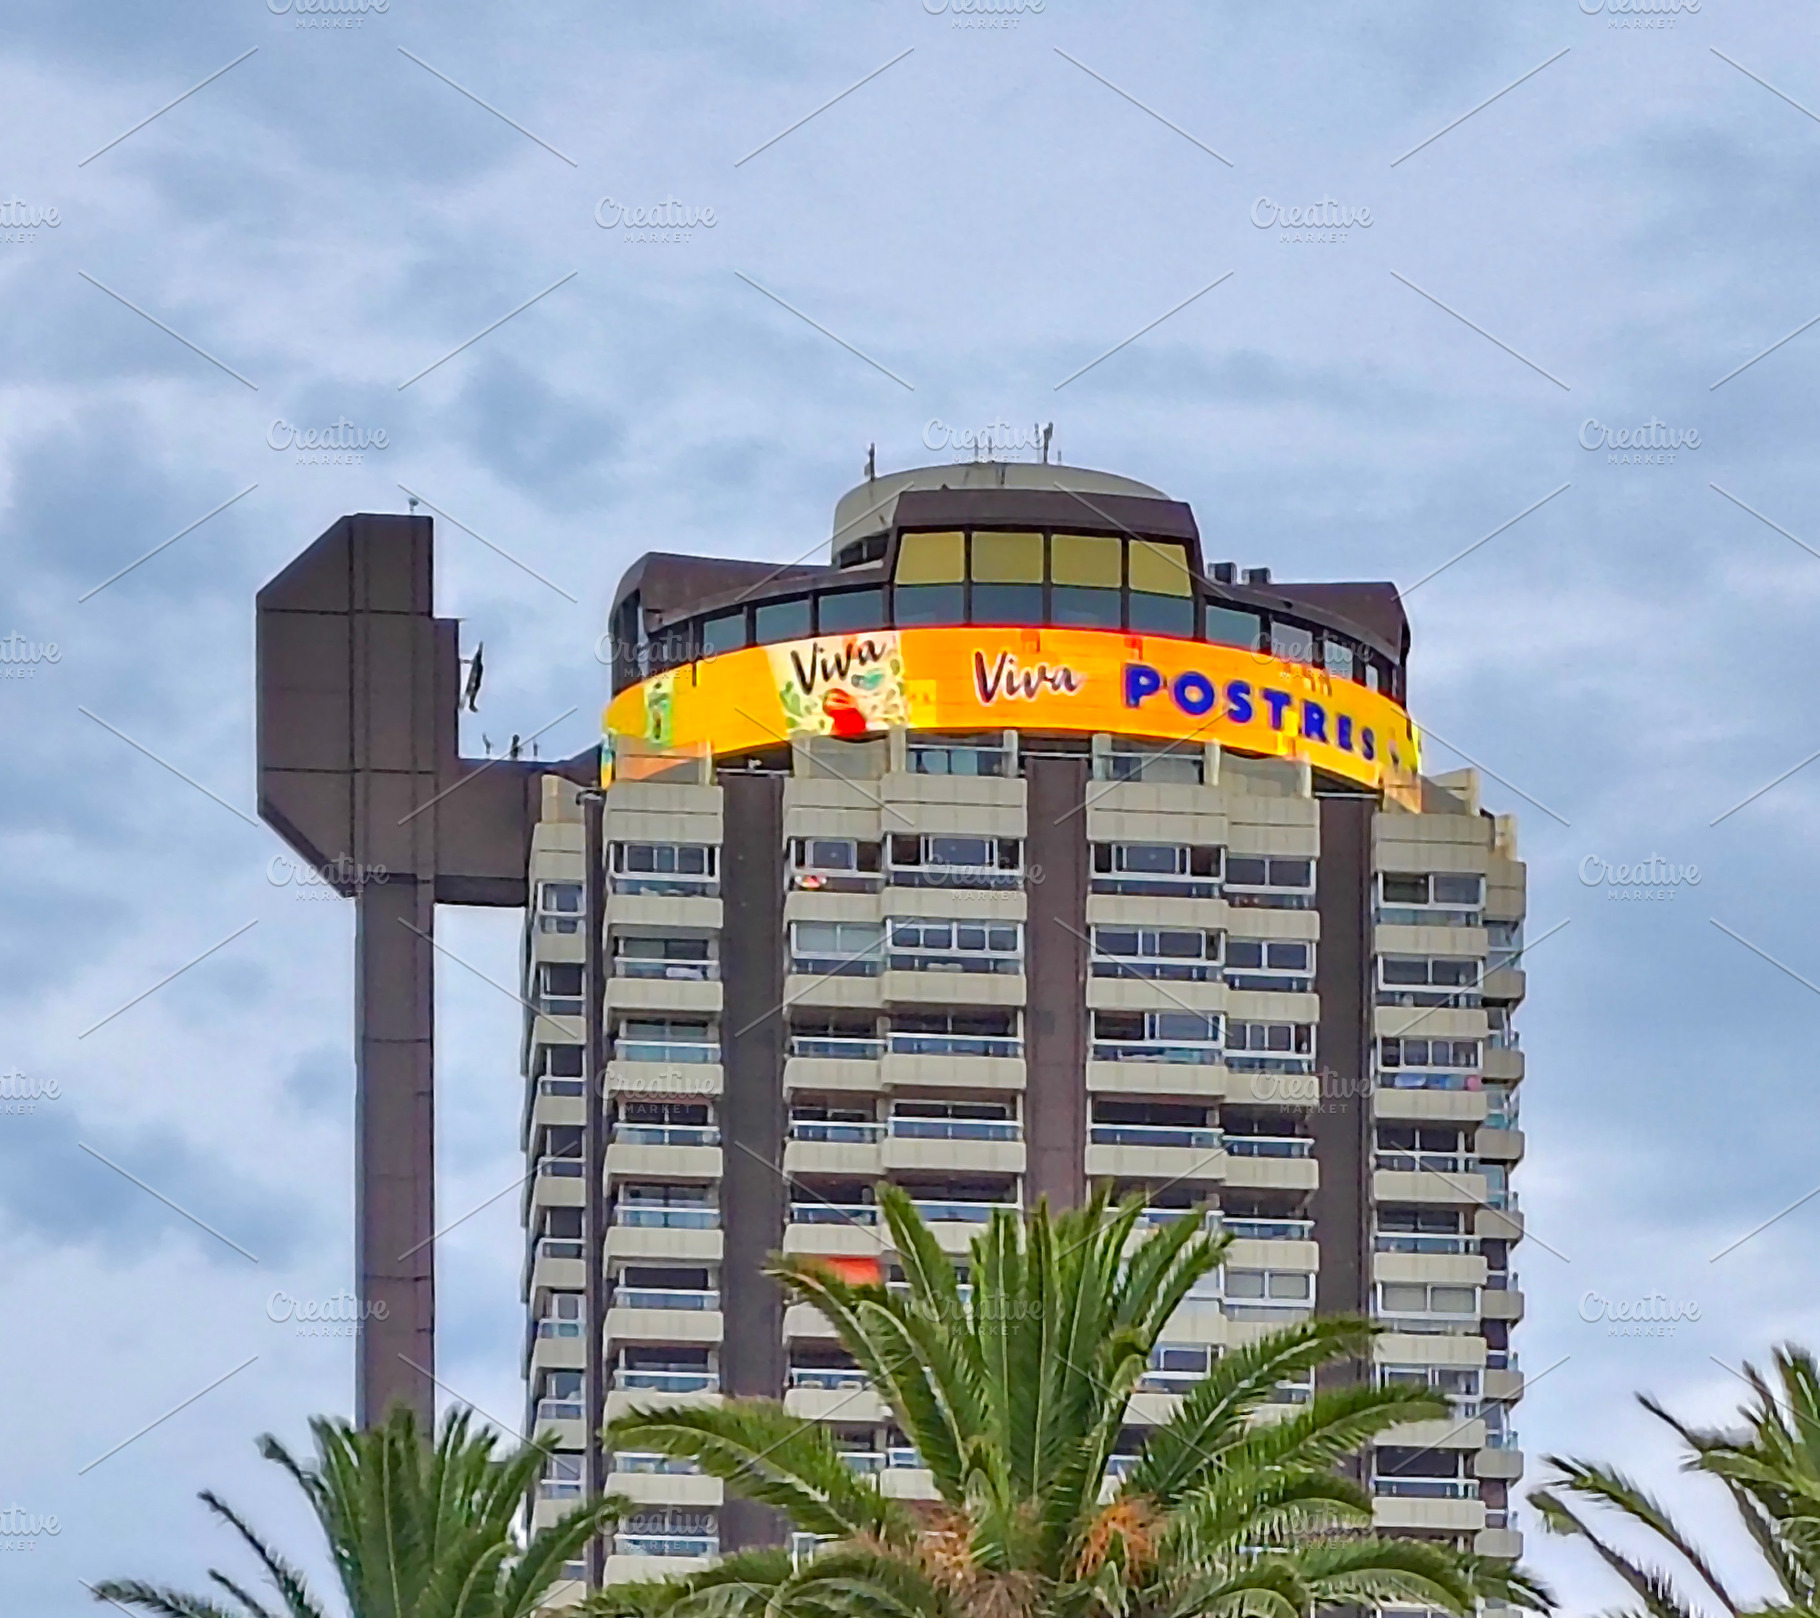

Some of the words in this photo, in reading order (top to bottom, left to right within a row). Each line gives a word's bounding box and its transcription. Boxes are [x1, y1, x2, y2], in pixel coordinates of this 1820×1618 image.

[790, 640, 887, 696] Viva
[974, 650, 1079, 704] Viva
[1124, 662, 1375, 761] POSTRES
